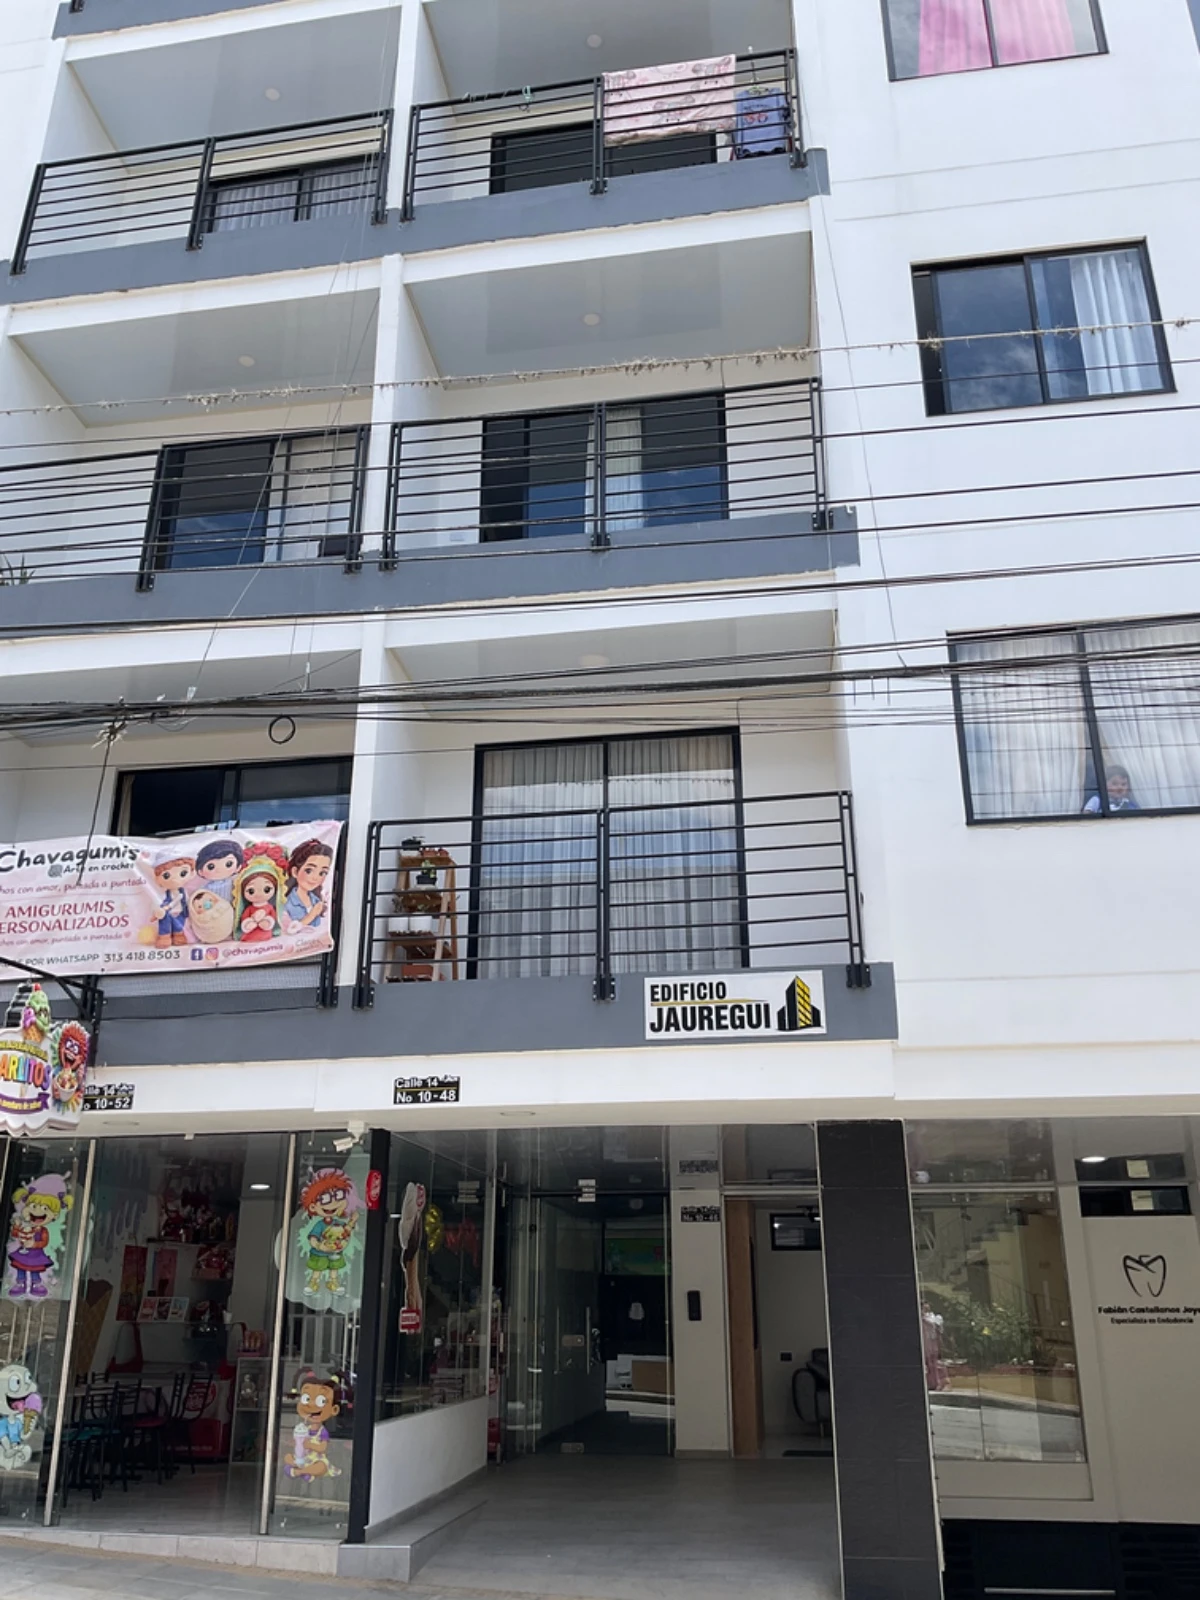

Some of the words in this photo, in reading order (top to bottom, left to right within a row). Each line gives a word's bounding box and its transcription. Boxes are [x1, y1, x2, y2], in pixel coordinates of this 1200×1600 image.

[88, 864, 99, 872] en
[5, 900, 115, 919] AMIGURUMIS
[46, 953, 100, 965] WHATSAPP
[104, 953, 123, 963] 313
[125, 951, 146, 961] 418
[147, 950, 180, 961] 8503
[650, 981, 727, 1002] EDIFICIO
[650, 1003, 771, 1032] JAUREGUI
[396, 1078, 422, 1088] Calle
[426, 1077, 438, 1088] 14
[103, 1084, 115, 1096] 14
[396, 1091, 413, 1103] No
[417, 1089, 456, 1102] 10-48
[95, 1097, 130, 1109] 10-52
[1129, 1305, 1180, 1314] Castellanos
